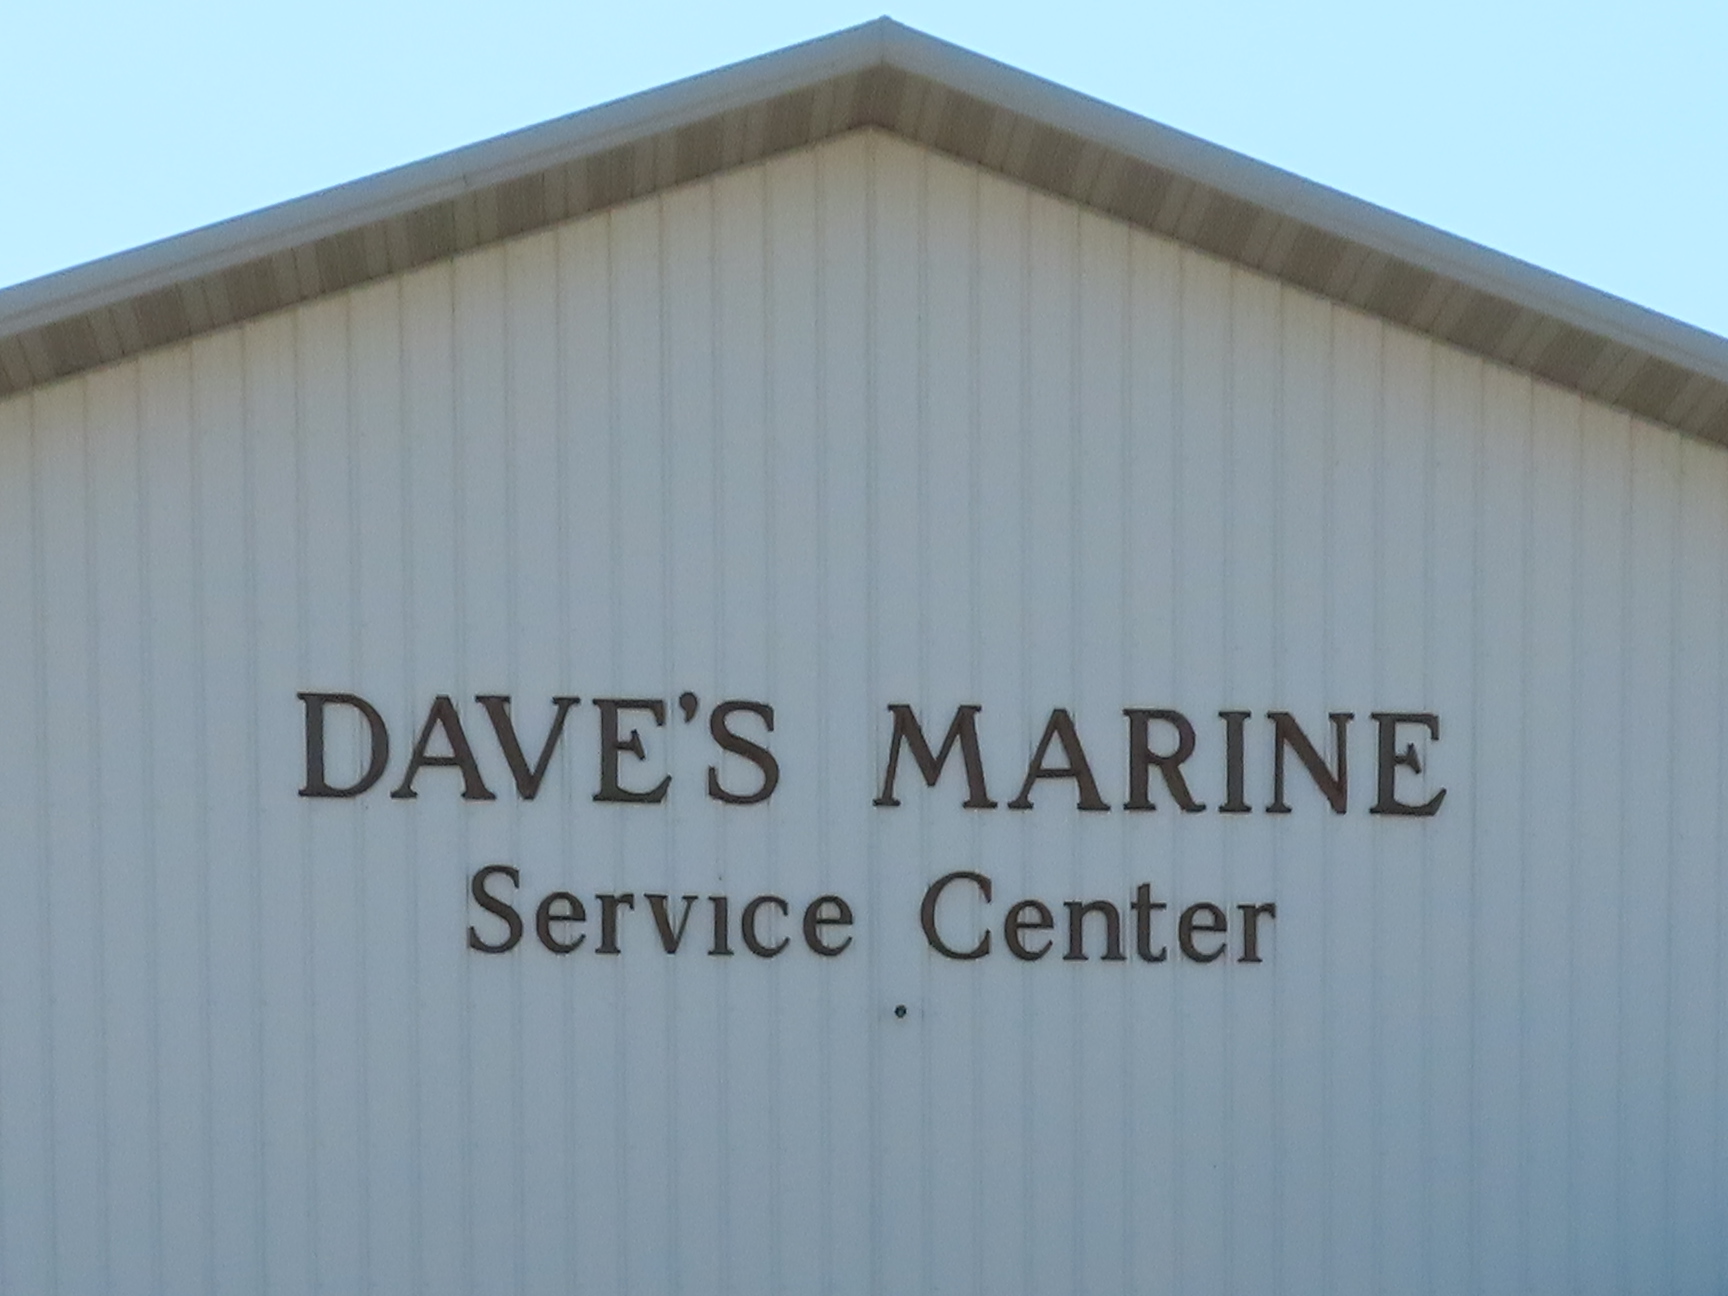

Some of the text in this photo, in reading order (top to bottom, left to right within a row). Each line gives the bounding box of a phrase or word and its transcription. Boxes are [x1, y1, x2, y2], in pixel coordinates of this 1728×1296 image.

[295, 690, 1449, 818] DAVE'S MARINE
[466, 862, 1278, 965] Service Center
